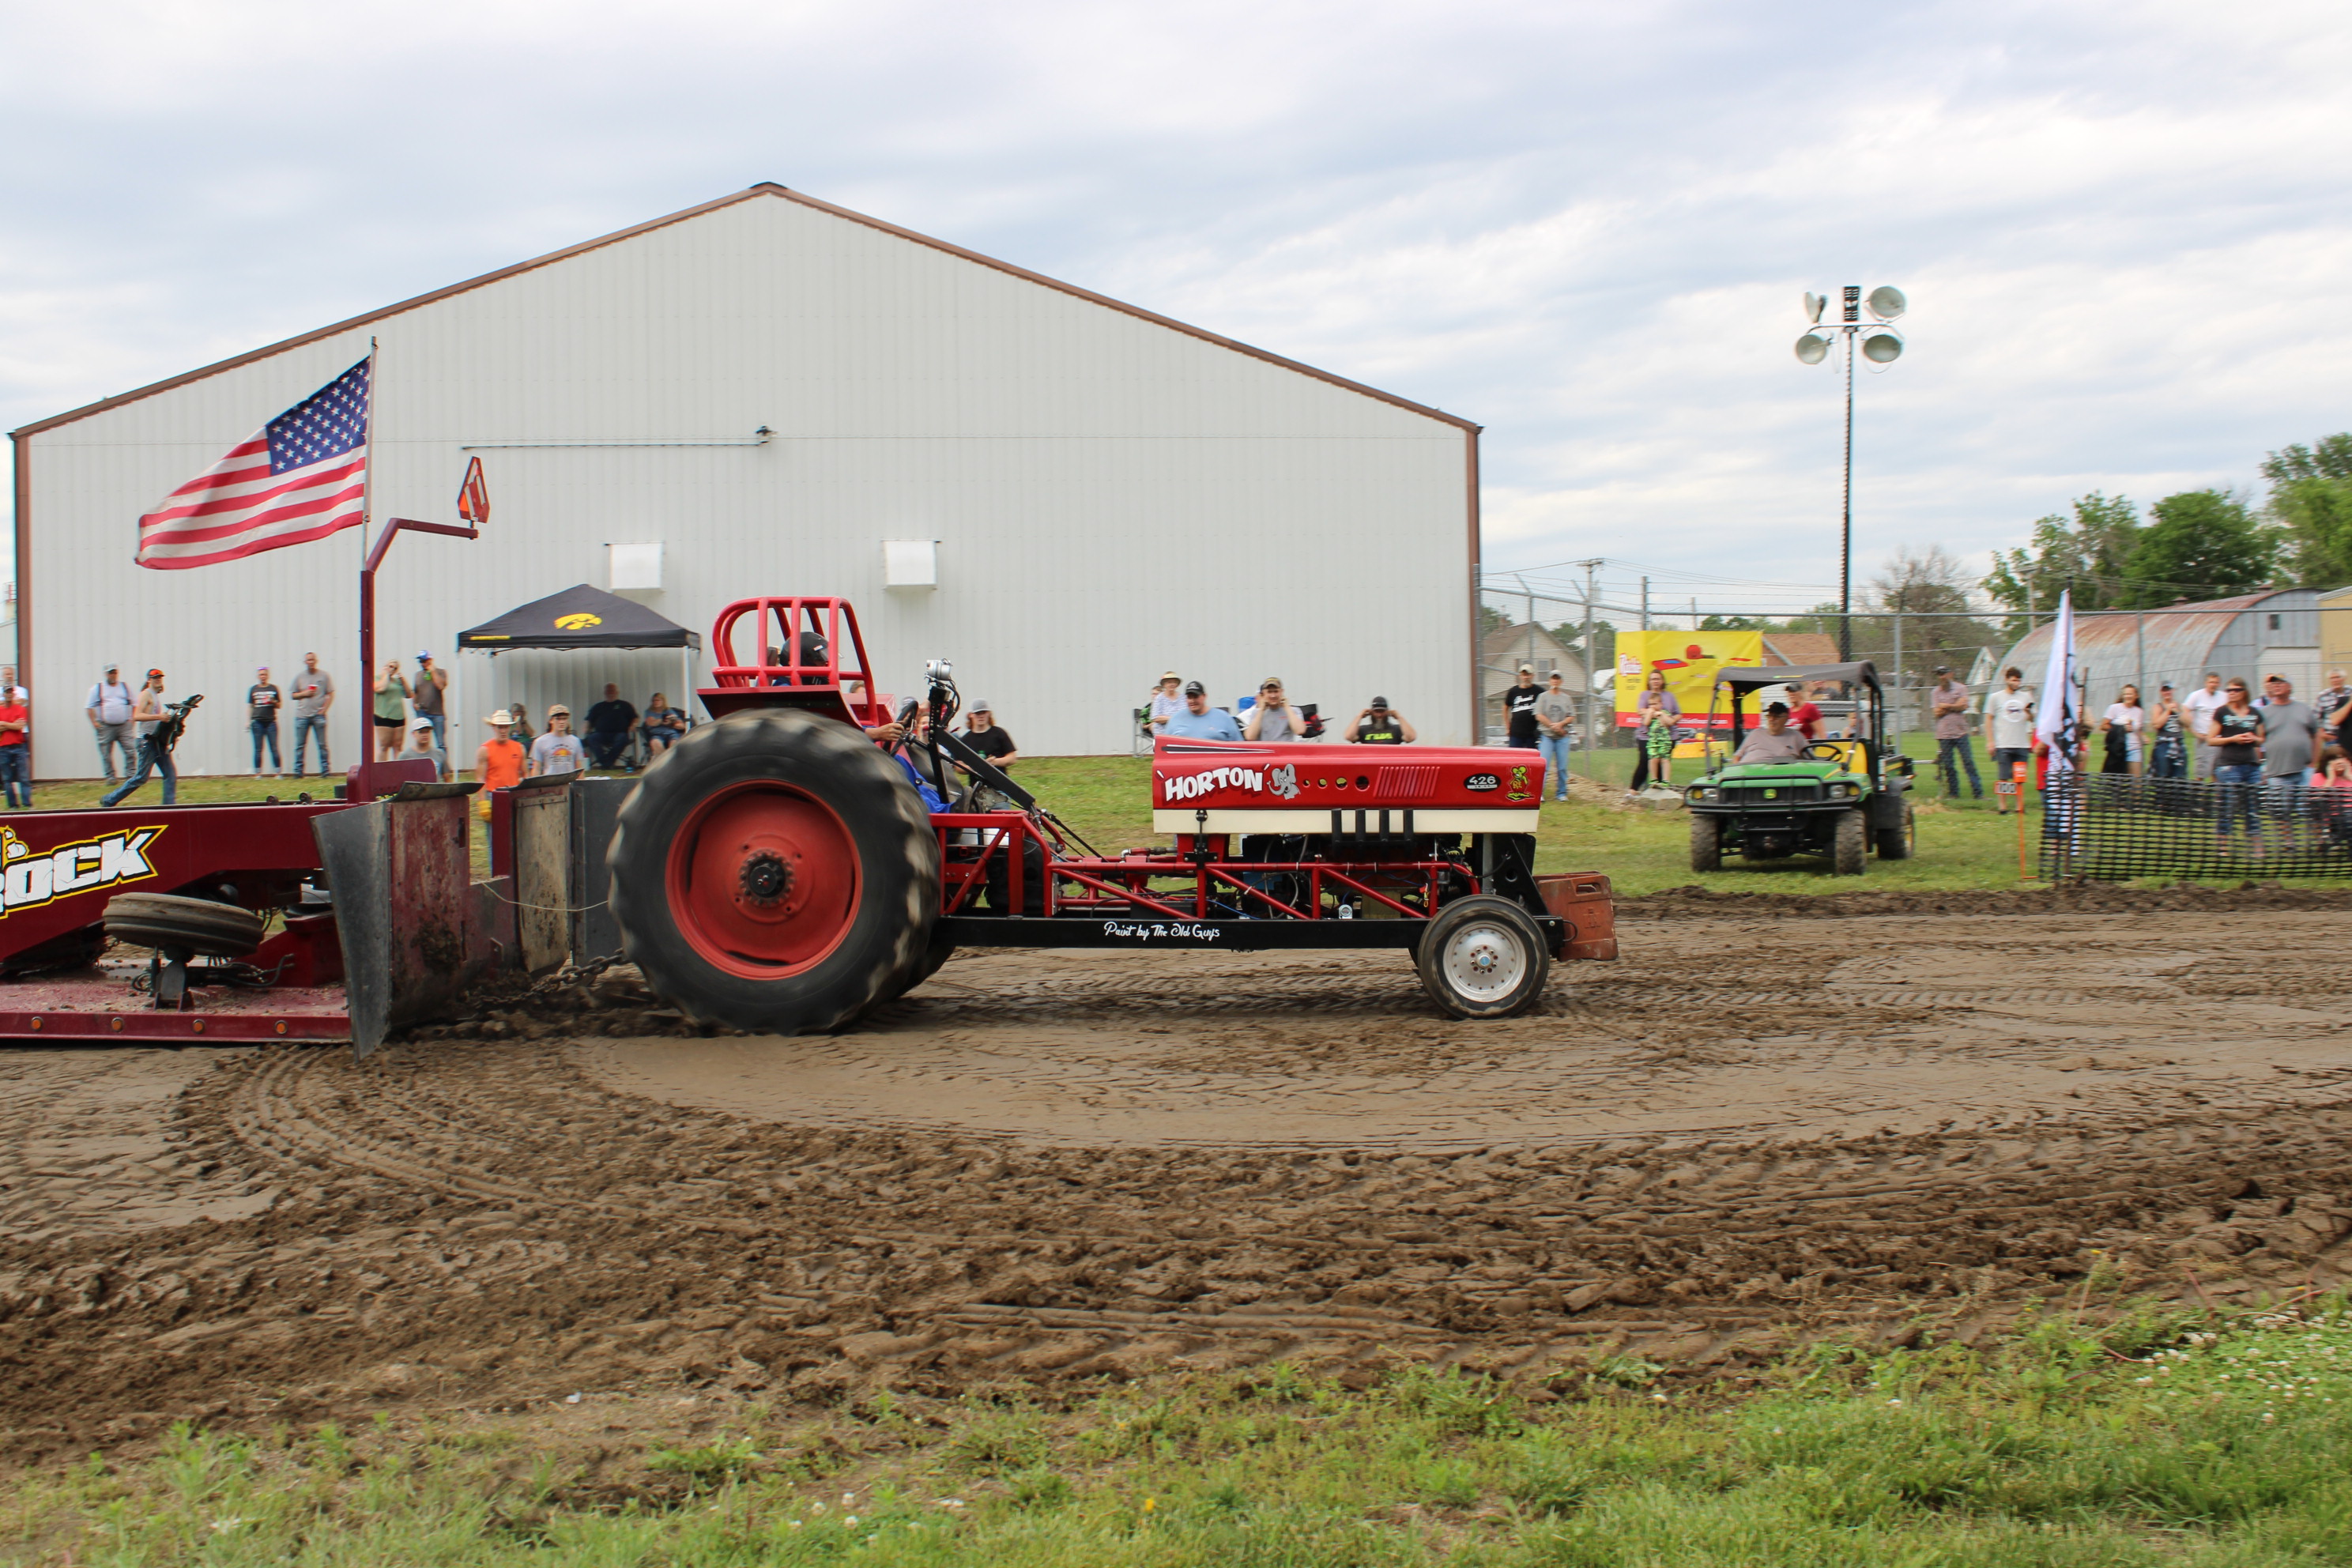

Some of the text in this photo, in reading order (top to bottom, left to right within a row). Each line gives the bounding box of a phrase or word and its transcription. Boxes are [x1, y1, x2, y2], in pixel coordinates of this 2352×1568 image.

[1469, 776, 1496, 785] 426
[0, 832, 153, 913] OCK
[1103, 921, 1220, 941] Paint by The Old Guys
